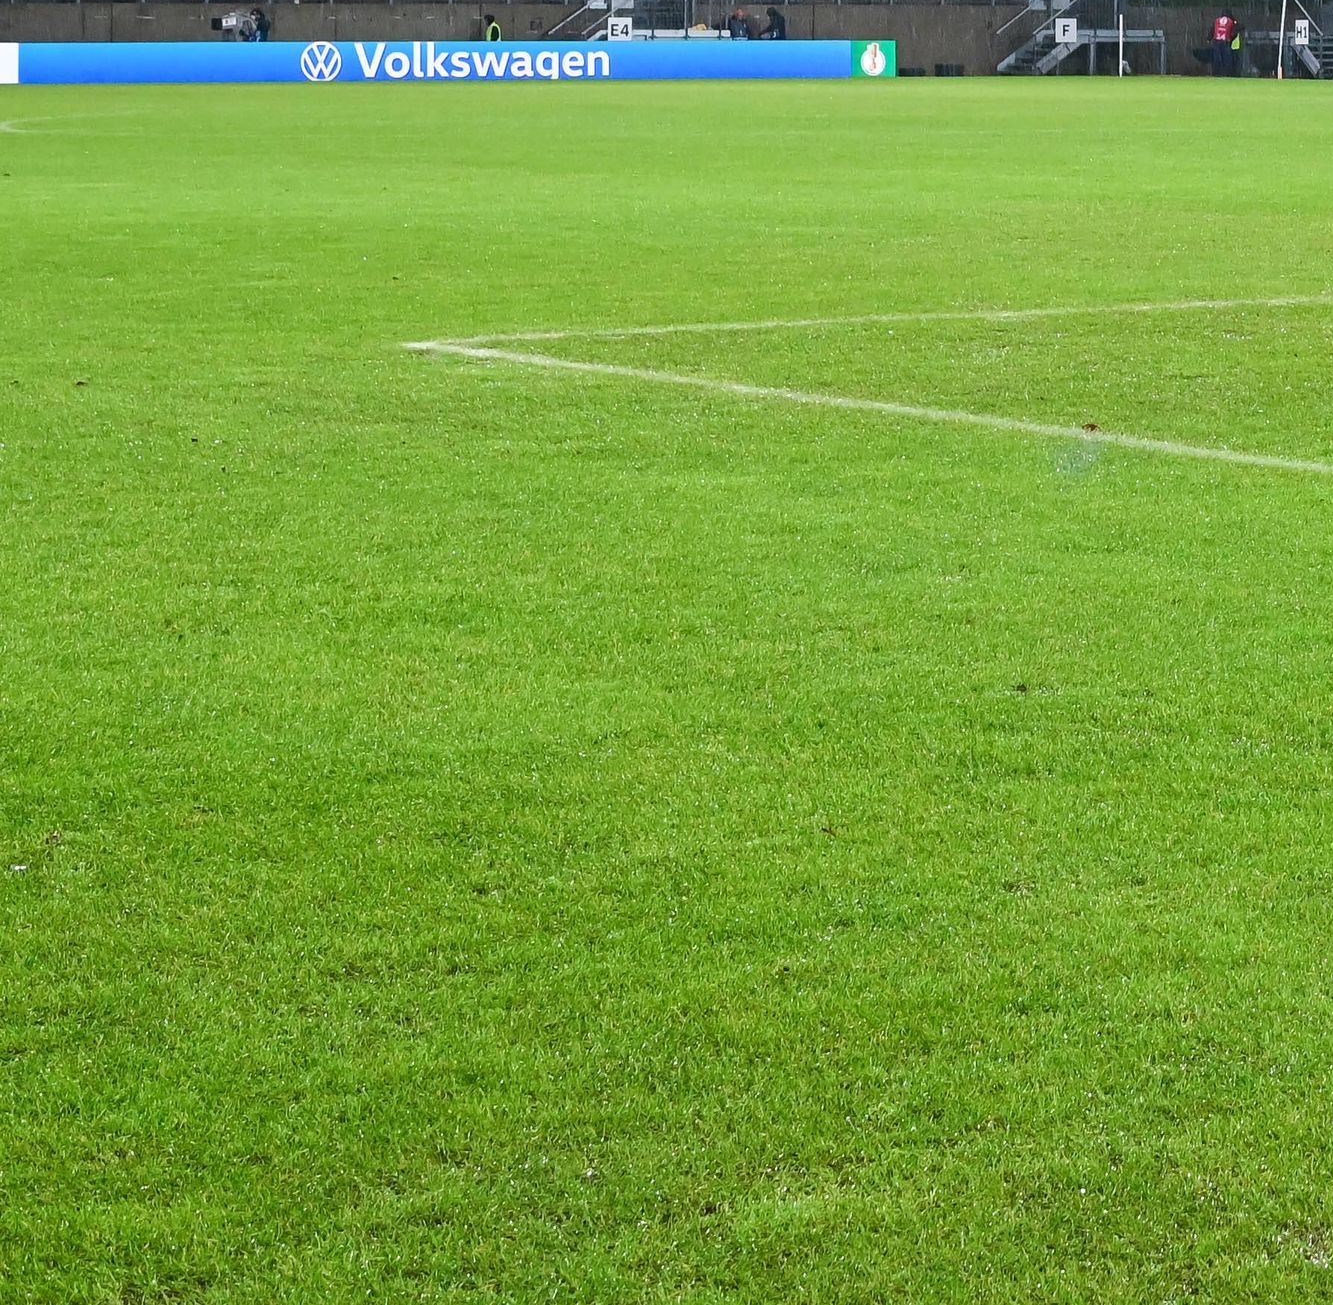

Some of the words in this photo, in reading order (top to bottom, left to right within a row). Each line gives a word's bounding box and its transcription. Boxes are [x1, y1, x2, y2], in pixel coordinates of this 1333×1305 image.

[610, 23, 630, 38] E4
[1062, 24, 1071, 37] F
[1296, 25, 1307, 39] H1
[353, 41, 611, 80] Volkswagen
